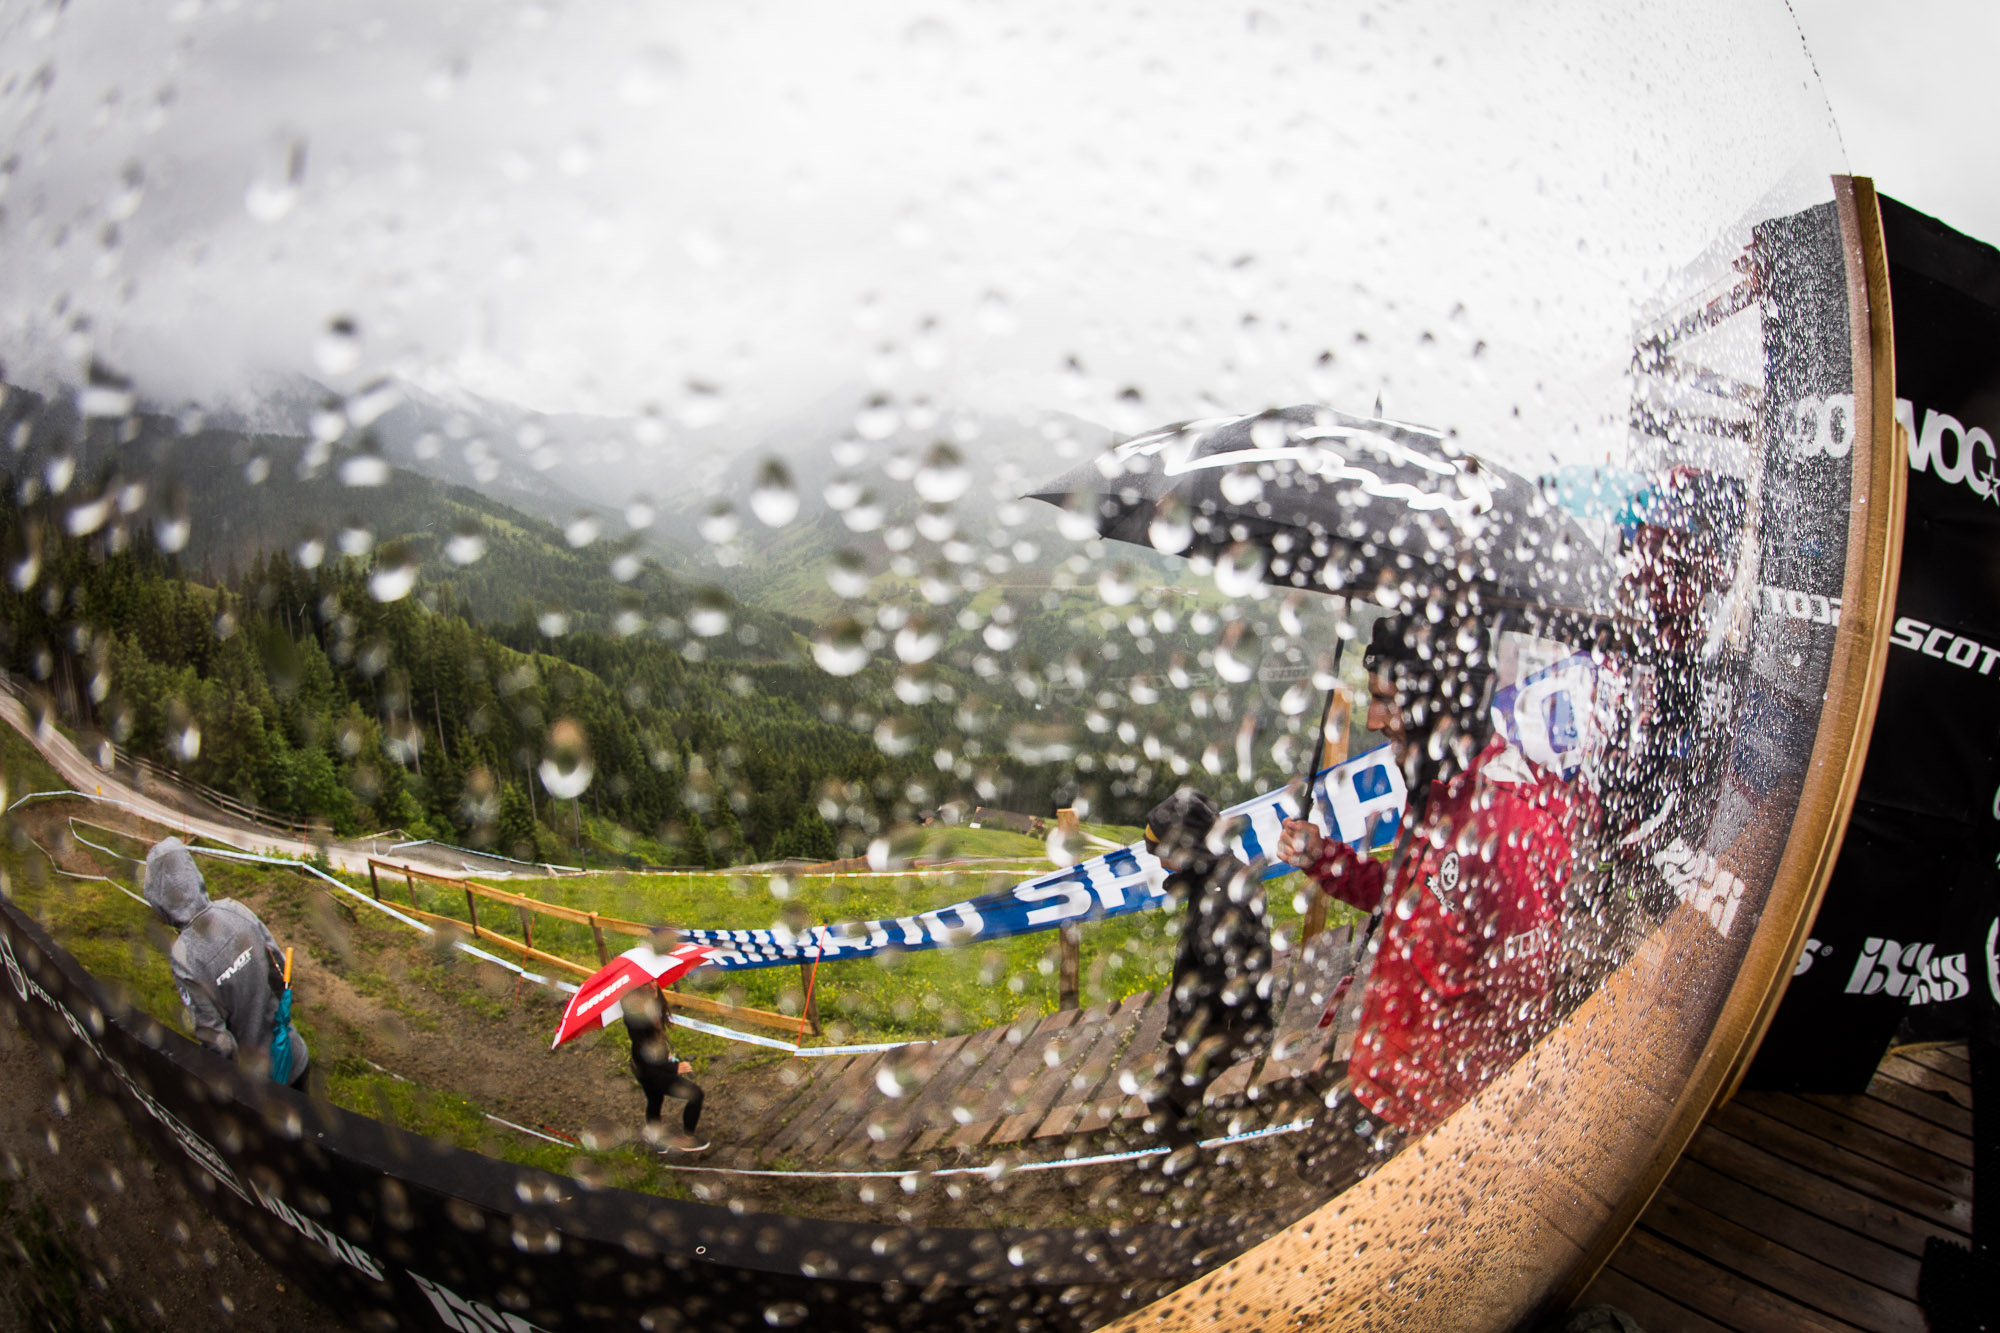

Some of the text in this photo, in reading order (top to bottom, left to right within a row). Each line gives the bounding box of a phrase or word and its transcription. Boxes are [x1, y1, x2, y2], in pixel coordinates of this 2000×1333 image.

[1889, 616, 2000, 680] SCOT
[216, 946, 253, 986] PIVOT
[576, 974, 631, 1017] SRAM
